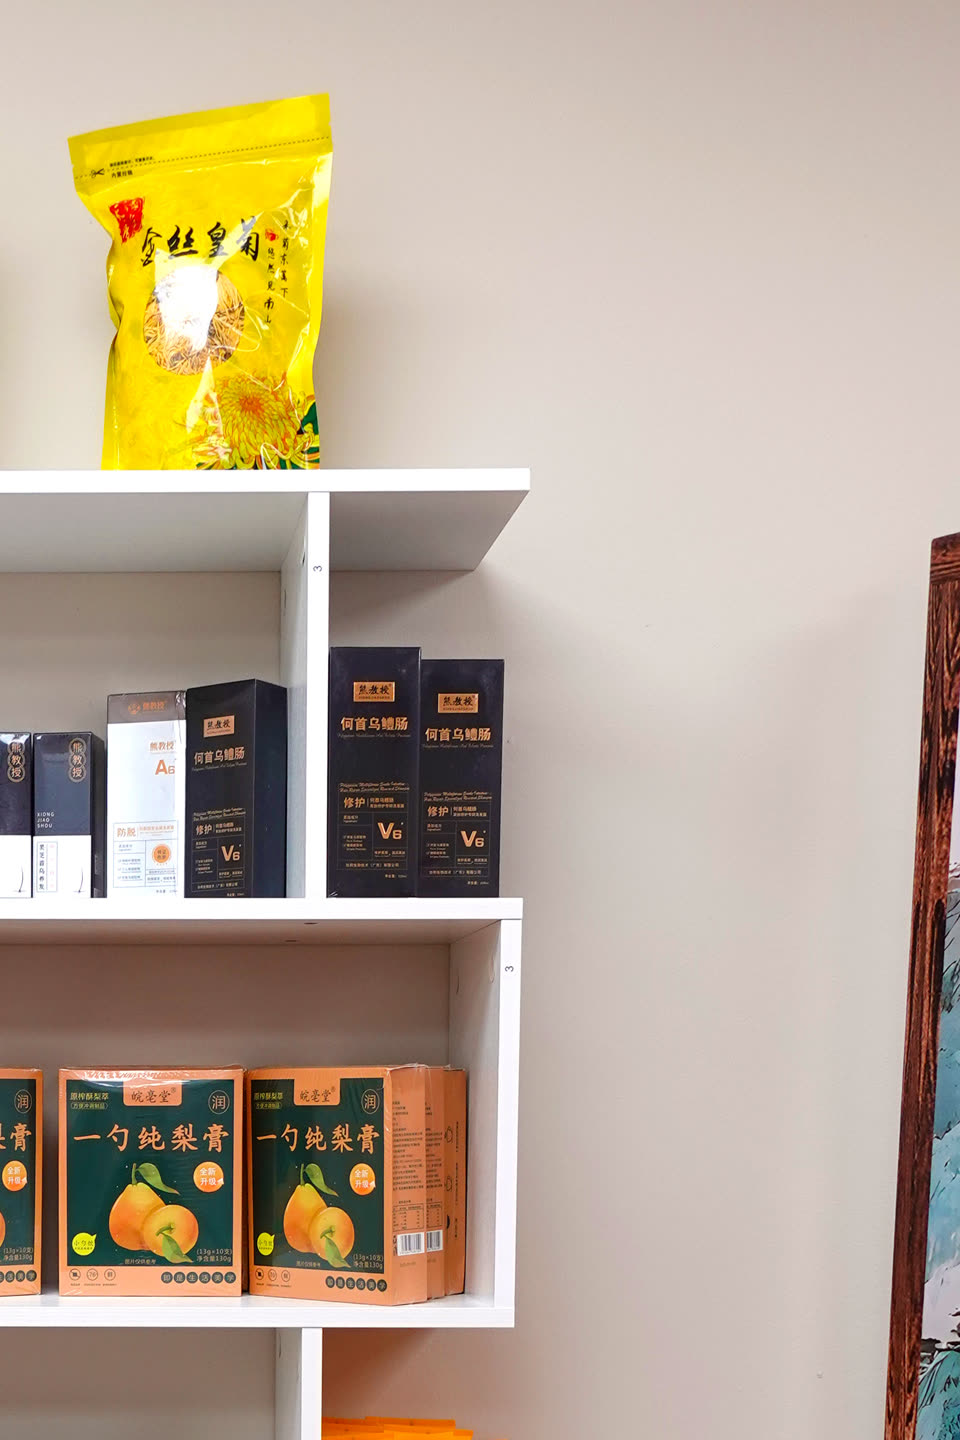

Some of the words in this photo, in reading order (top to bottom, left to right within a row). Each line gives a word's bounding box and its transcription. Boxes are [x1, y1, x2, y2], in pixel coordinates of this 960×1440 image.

[141, 215, 260, 267] 金丝皇菊
[264, 246, 276, 324] 悠然见南山
[11, 742, 21, 778] 熊教授
[72, 742, 82, 777] 熊教授
[155, 760, 175, 775] A6
[343, 797, 365, 808] 修护
[427, 806, 448, 817] 修护
[196, 824, 212, 835] 修护
[378, 822, 402, 839] V6
[461, 830, 485, 847] V6
[221, 845, 240, 861] V6
[17, 1094, 29, 1109] 润
[212, 1095, 225, 1110] 润
[364, 1094, 376, 1110] 润
[73, 1123, 229, 1152] 一勺纯梨膏
[256, 1123, 380, 1155] 一勺纯梨膏
[7, 1166, 21, 1175] 全新
[199, 1168, 216, 1176] 全新
[354, 1169, 369, 1178] 全新
[7, 1176, 21, 1185] 升级
[200, 1177, 217, 1186] 升级
[355, 1179, 369, 1188] 升级
[197, 1255, 232, 1263] 净含量130g
[163, 1272, 234, 1282] 即是生活美学
